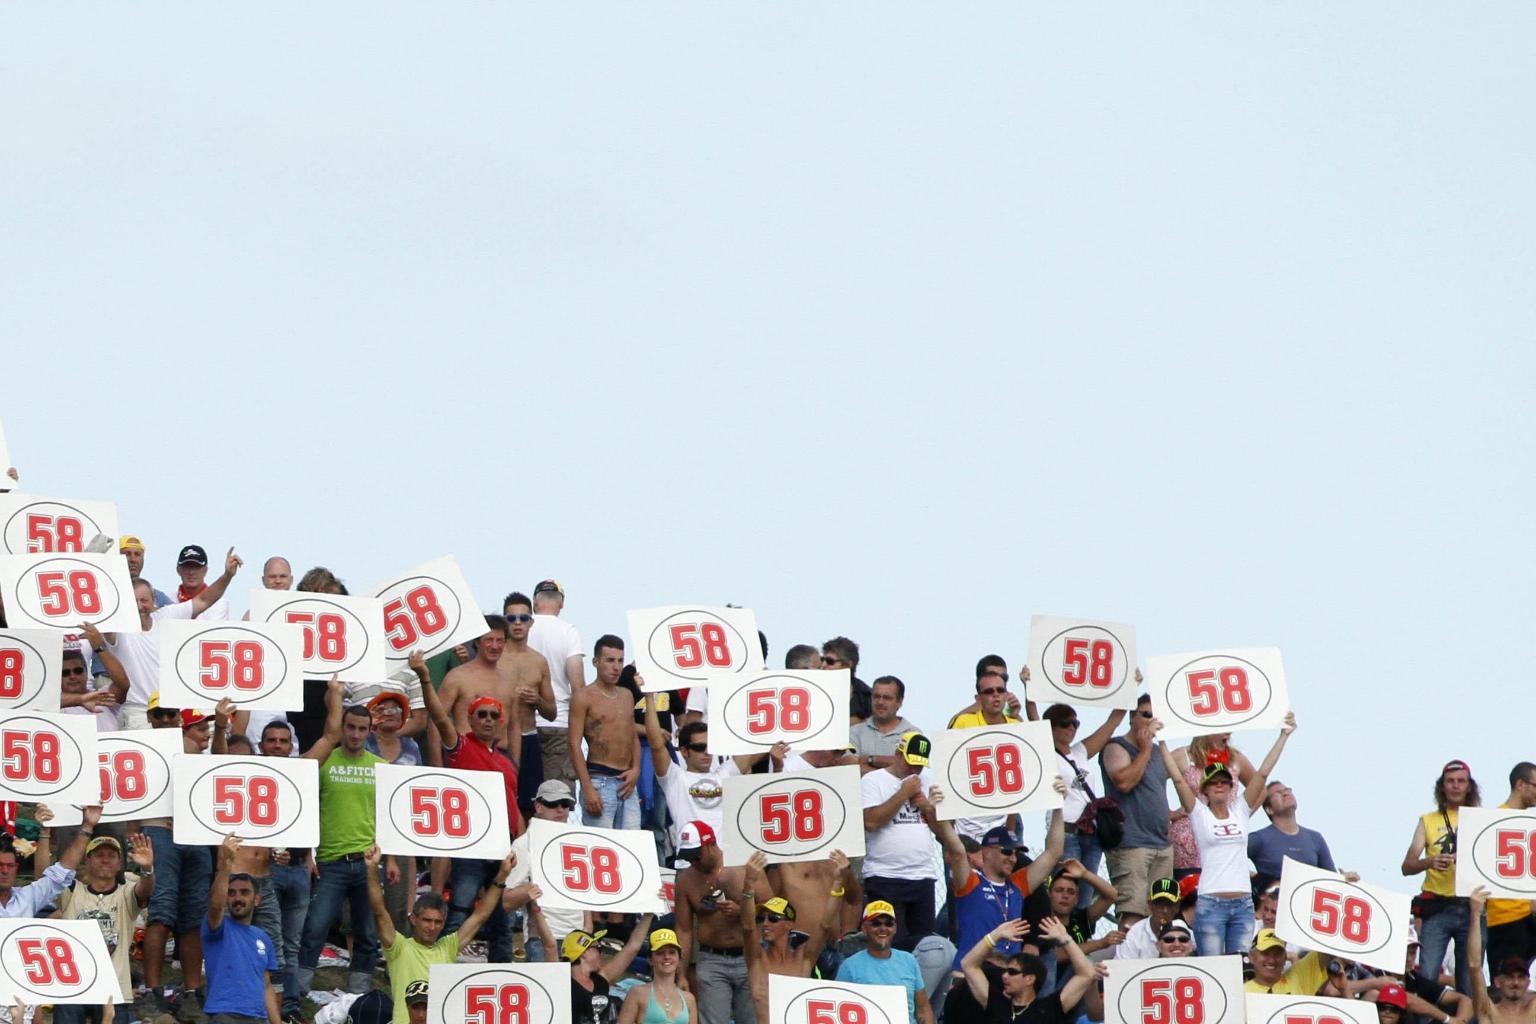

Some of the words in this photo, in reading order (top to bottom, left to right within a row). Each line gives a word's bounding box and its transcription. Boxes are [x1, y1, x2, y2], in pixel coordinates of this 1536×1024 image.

[26, 514, 85, 555] 58
[36, 569, 102, 617] 58
[380, 585, 448, 652] 58
[198, 640, 264, 691] 58
[668, 622, 733, 669] 58
[1061, 637, 1115, 689] 58
[746, 686, 811, 735] 58
[1186, 666, 1252, 716] 58
[1, 729, 62, 784] 58
[965, 742, 1025, 797] 58
[212, 775, 279, 827] 58
[409, 787, 471, 839] 58
[758, 788, 825, 844] 58
[560, 843, 622, 895] 58
[1495, 829, 1536, 879] 5
[1309, 888, 1373, 945] 58
[16, 937, 82, 986] 58
